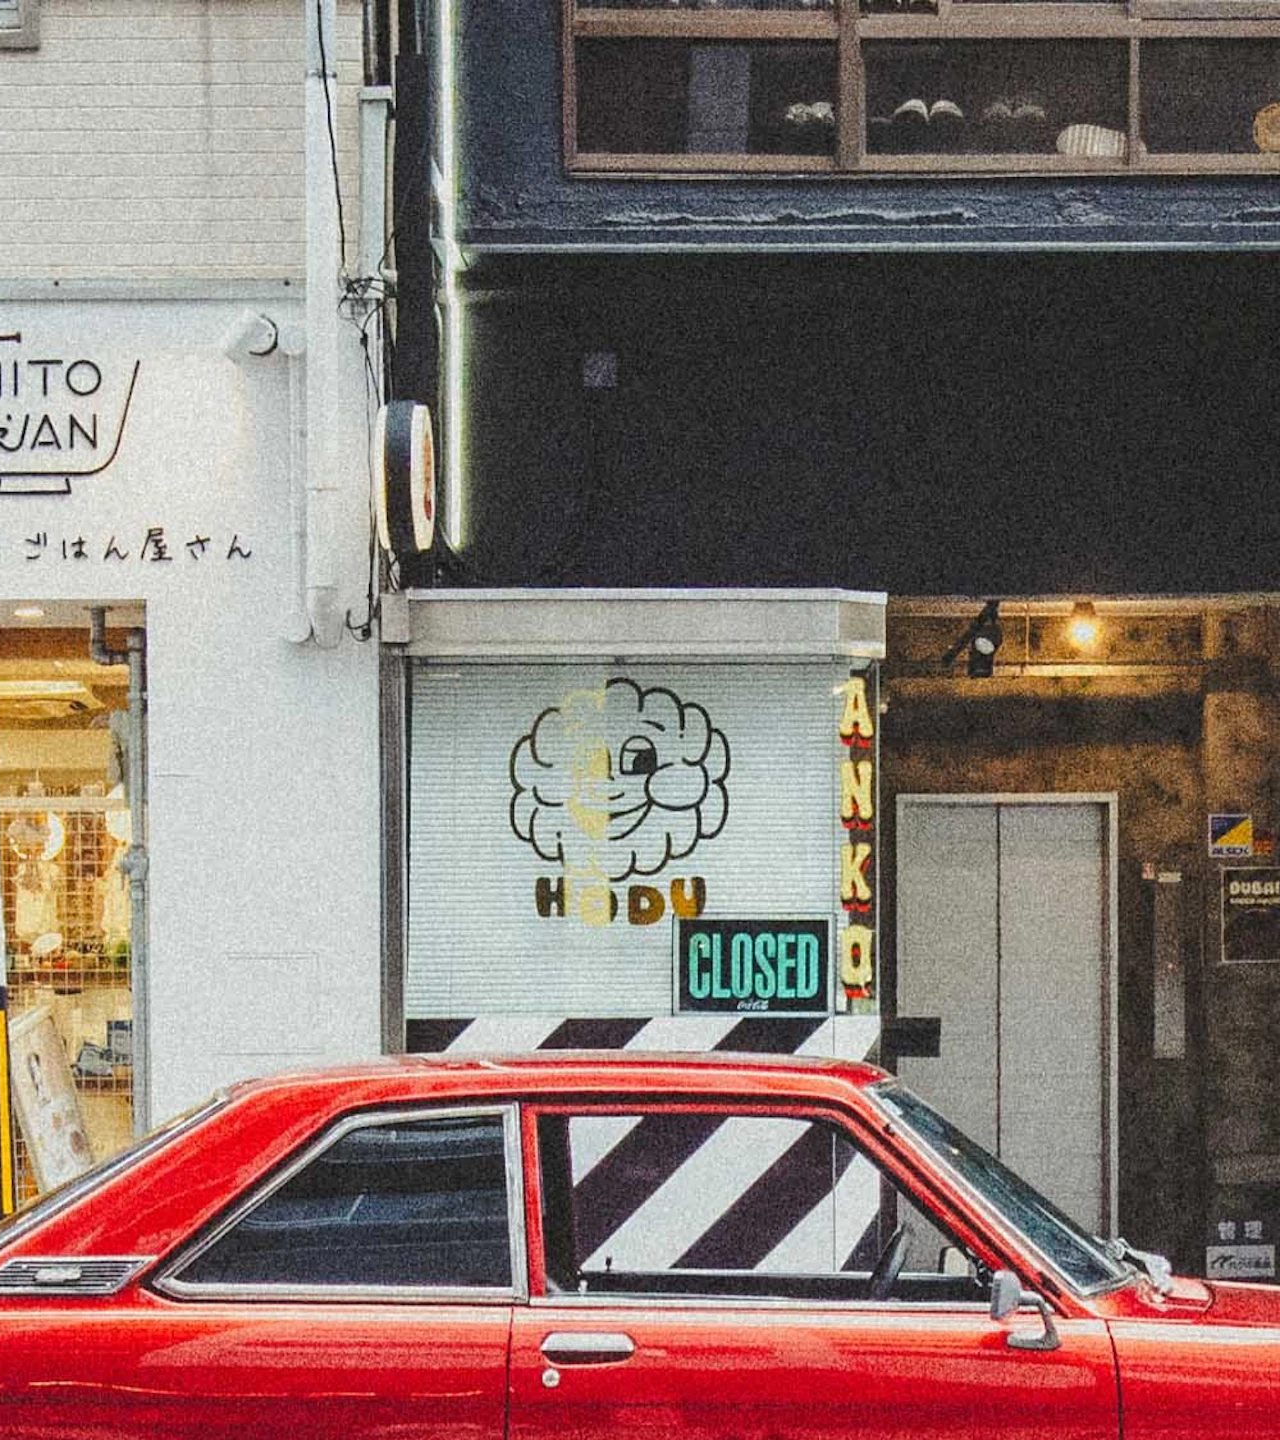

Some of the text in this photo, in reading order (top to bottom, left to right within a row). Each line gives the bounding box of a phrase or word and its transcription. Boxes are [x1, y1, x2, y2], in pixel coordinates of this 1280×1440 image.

[839, 675, 875, 999] ANKO
[534, 876, 707, 927] HODU
[688, 931, 820, 1000] CLOSED
